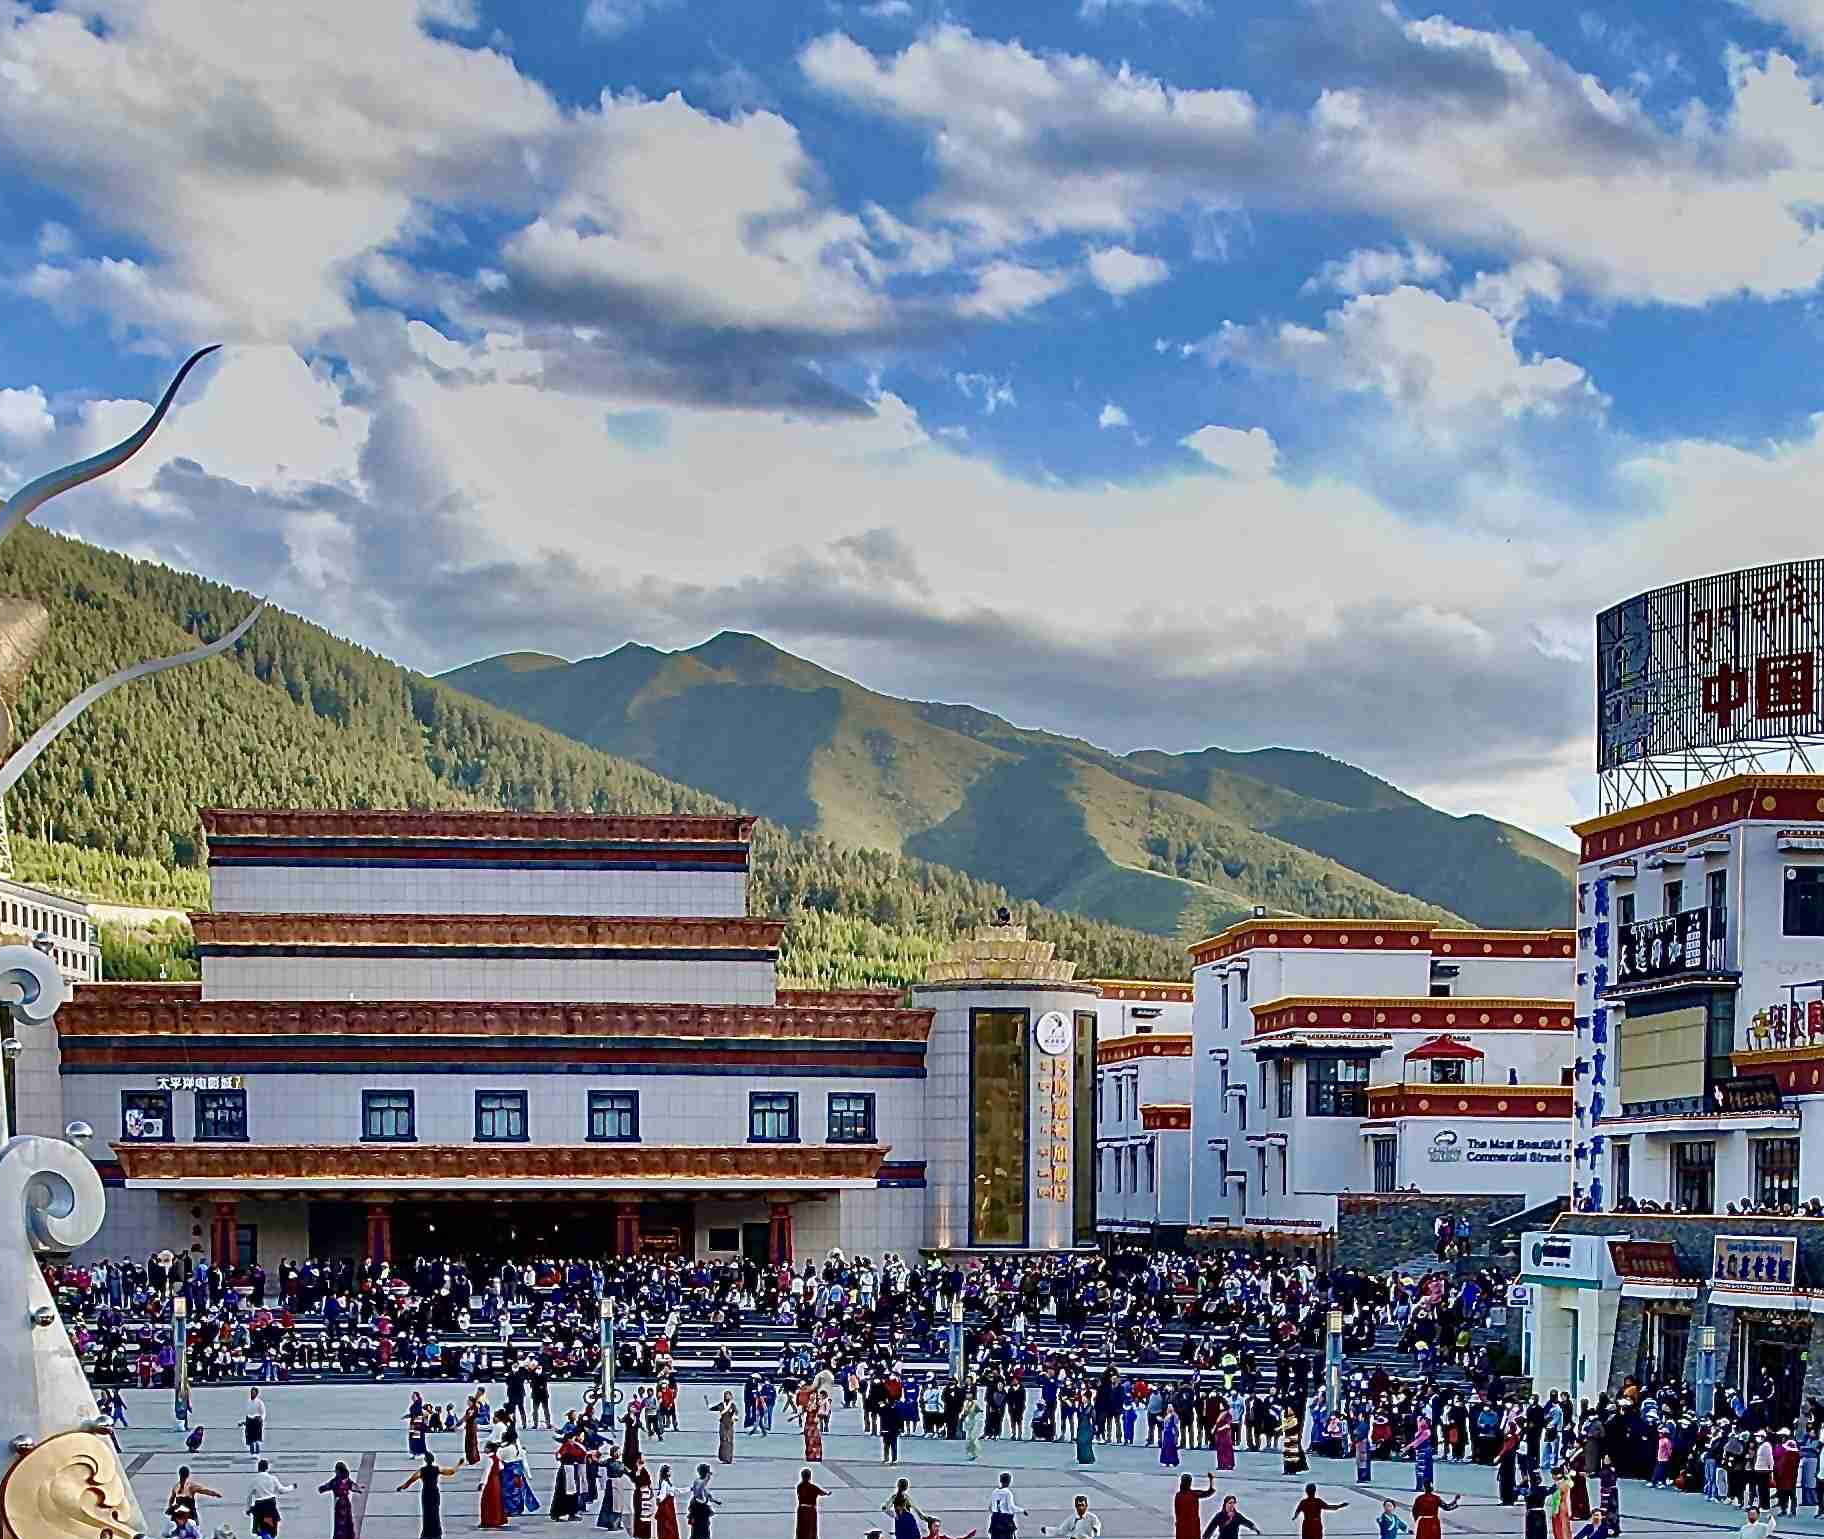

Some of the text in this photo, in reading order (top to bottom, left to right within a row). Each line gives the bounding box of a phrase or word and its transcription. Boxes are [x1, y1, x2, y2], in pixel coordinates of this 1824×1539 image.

[1467, 1138, 1487, 1149] The
[1490, 1138, 1514, 1149] Most
[1517, 1138, 1562, 1149] Beautiful
[1466, 1151, 1527, 1162] Commercial
[1530, 1151, 1562, 1162] Street
